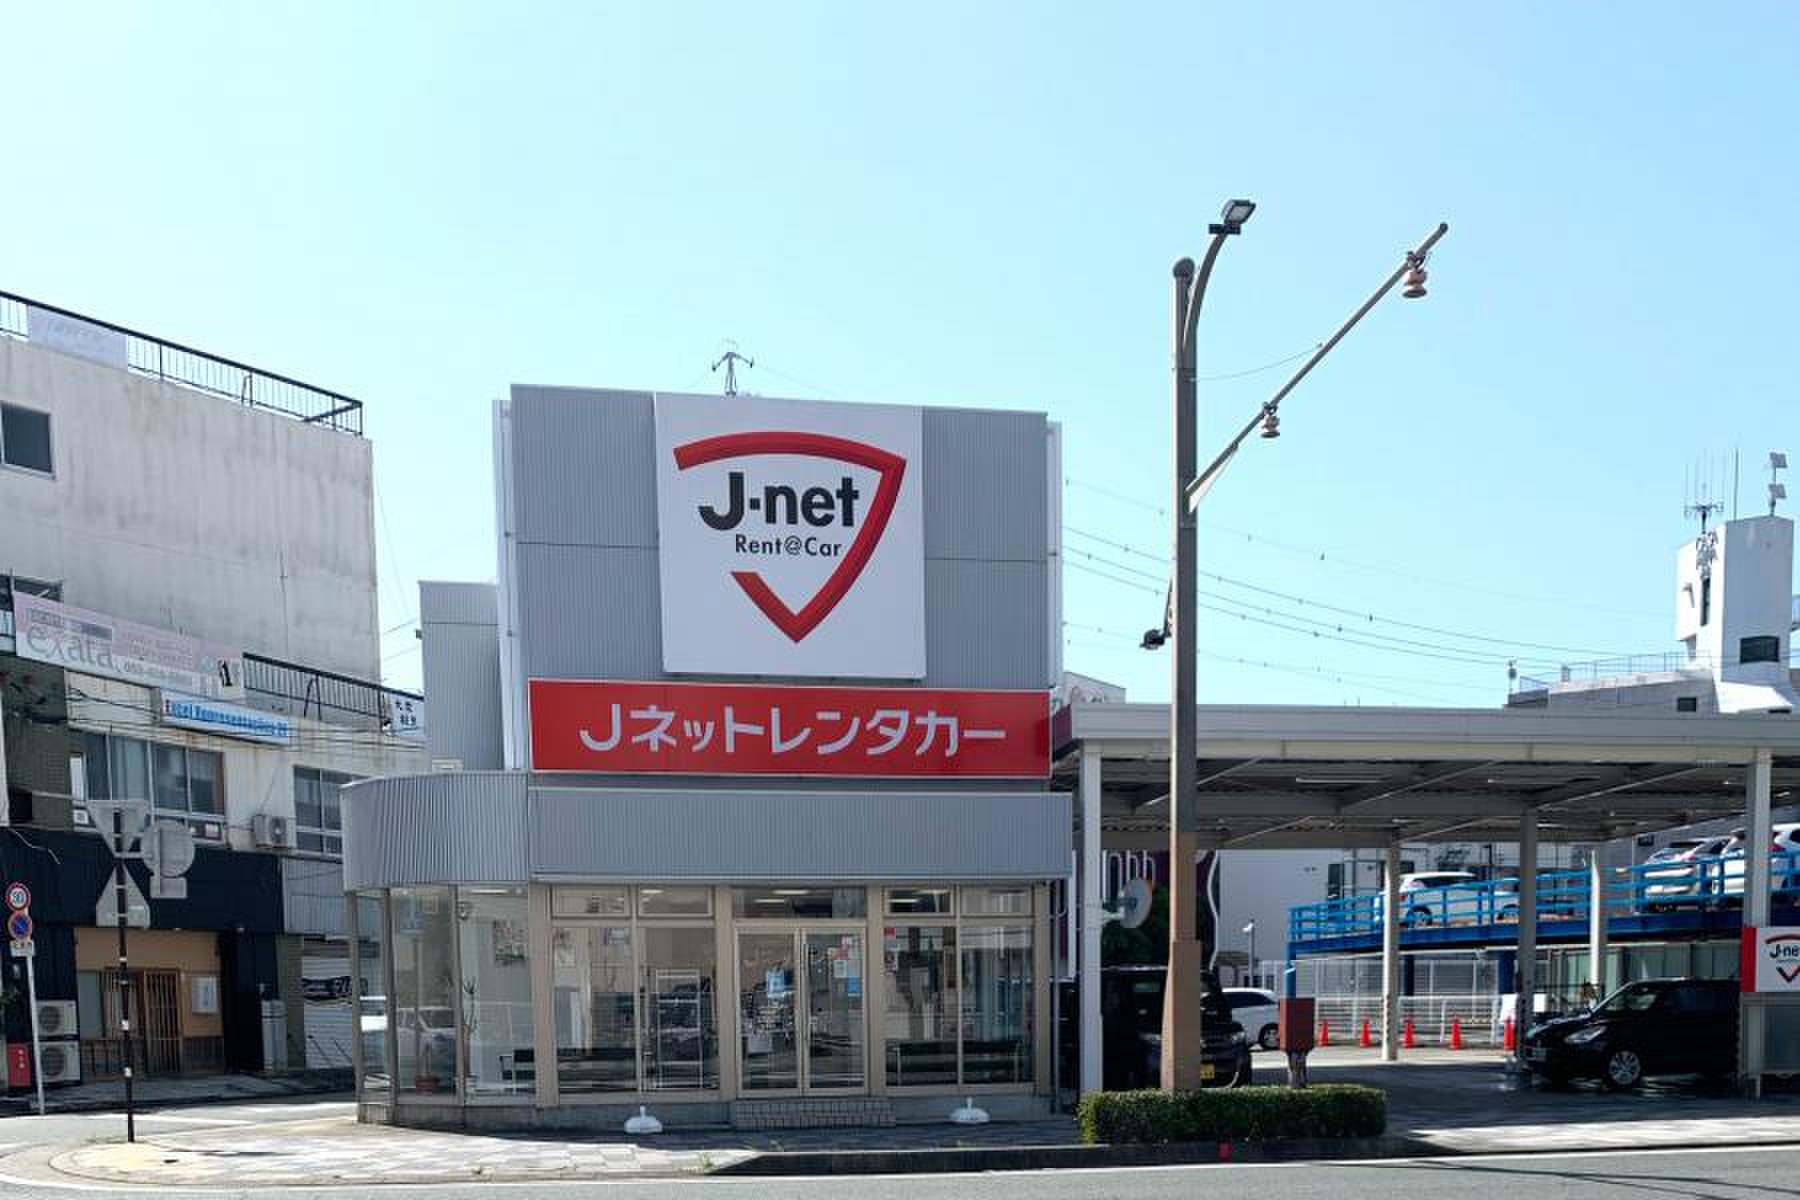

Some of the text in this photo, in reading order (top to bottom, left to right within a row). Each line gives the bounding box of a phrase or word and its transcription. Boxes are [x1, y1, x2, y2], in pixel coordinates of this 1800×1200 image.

[579, 703, 1006, 757] Jネットレンタカー
